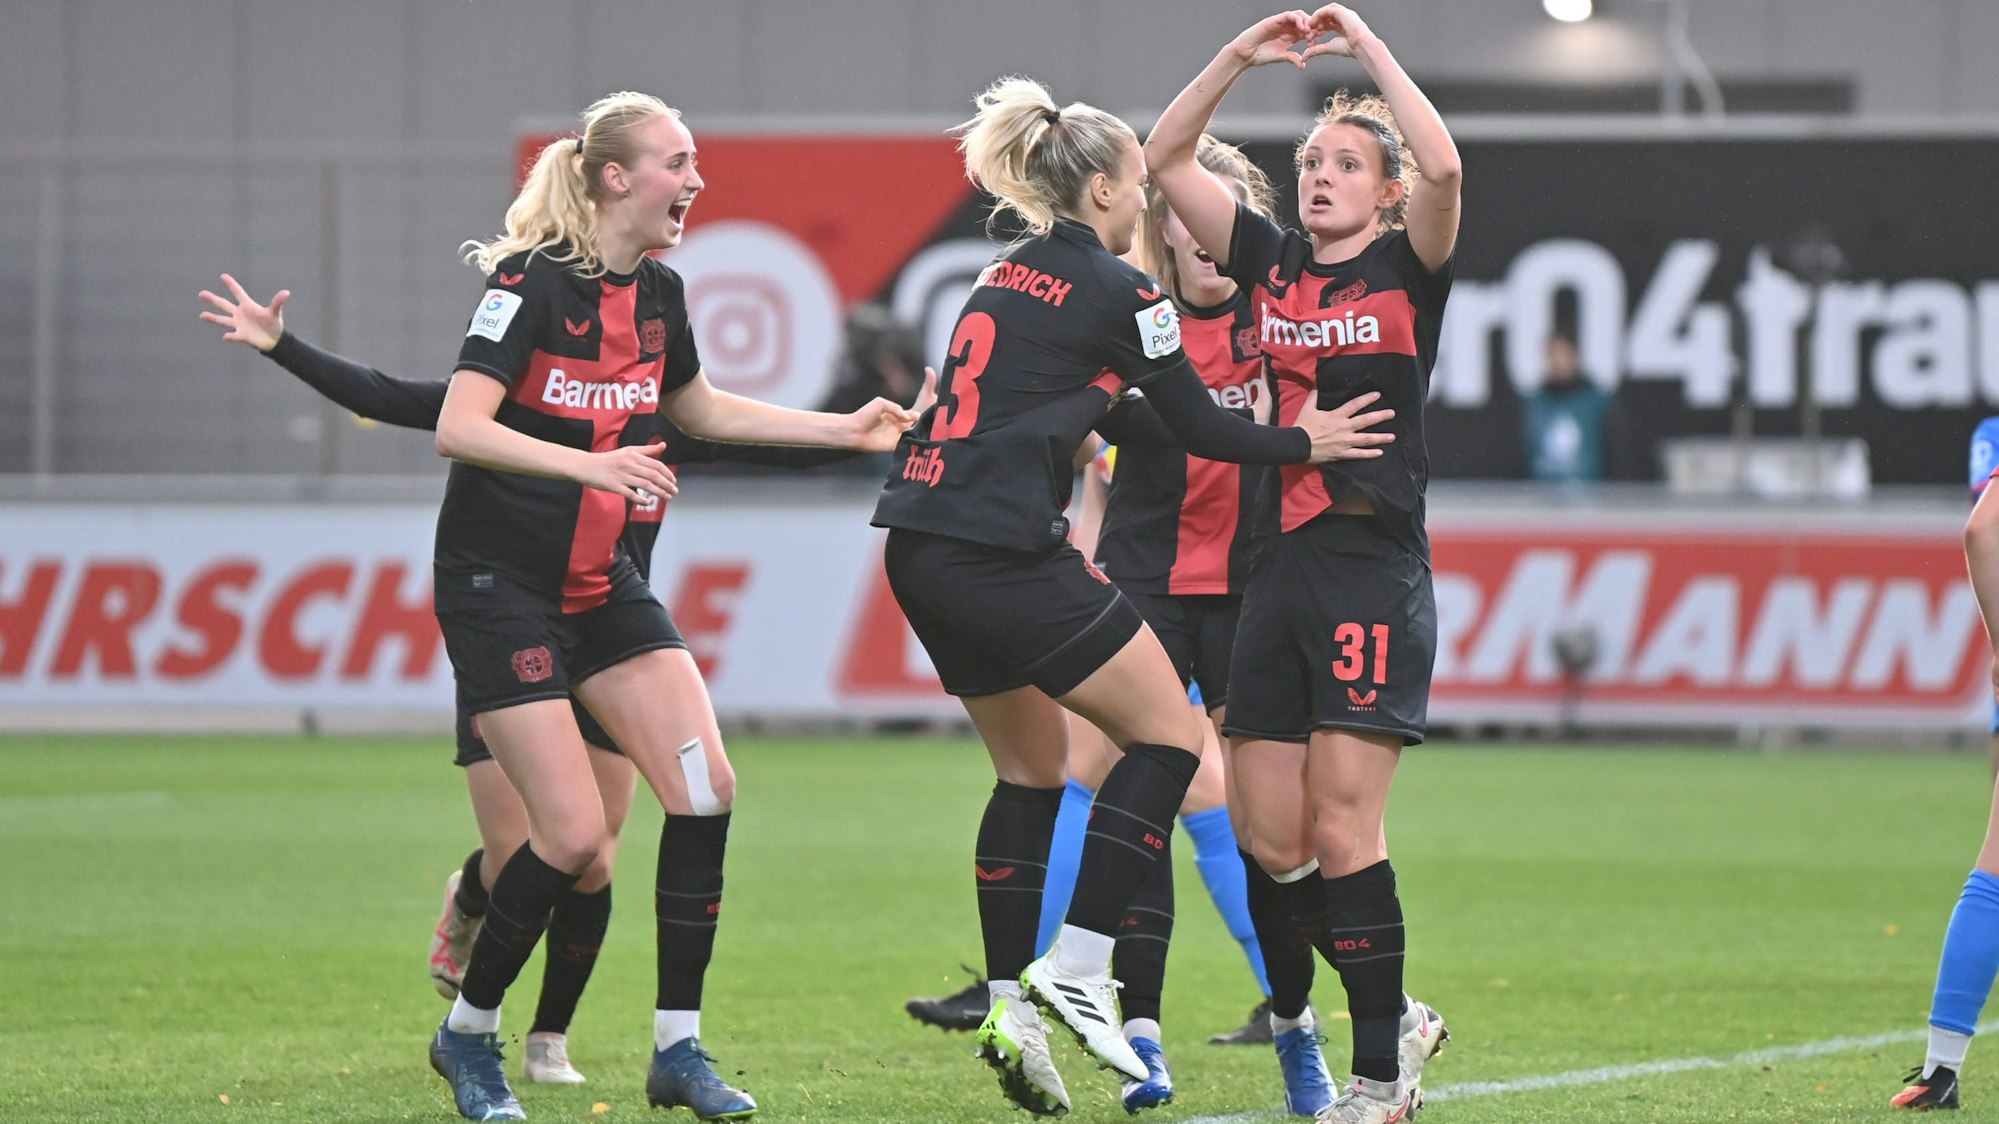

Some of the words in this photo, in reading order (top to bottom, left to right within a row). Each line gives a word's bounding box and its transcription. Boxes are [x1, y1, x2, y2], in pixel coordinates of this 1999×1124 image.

[1152, 327, 1178, 348] Pixel
[929, 311, 996, 442] 3
[1331, 622, 1390, 685] 31
